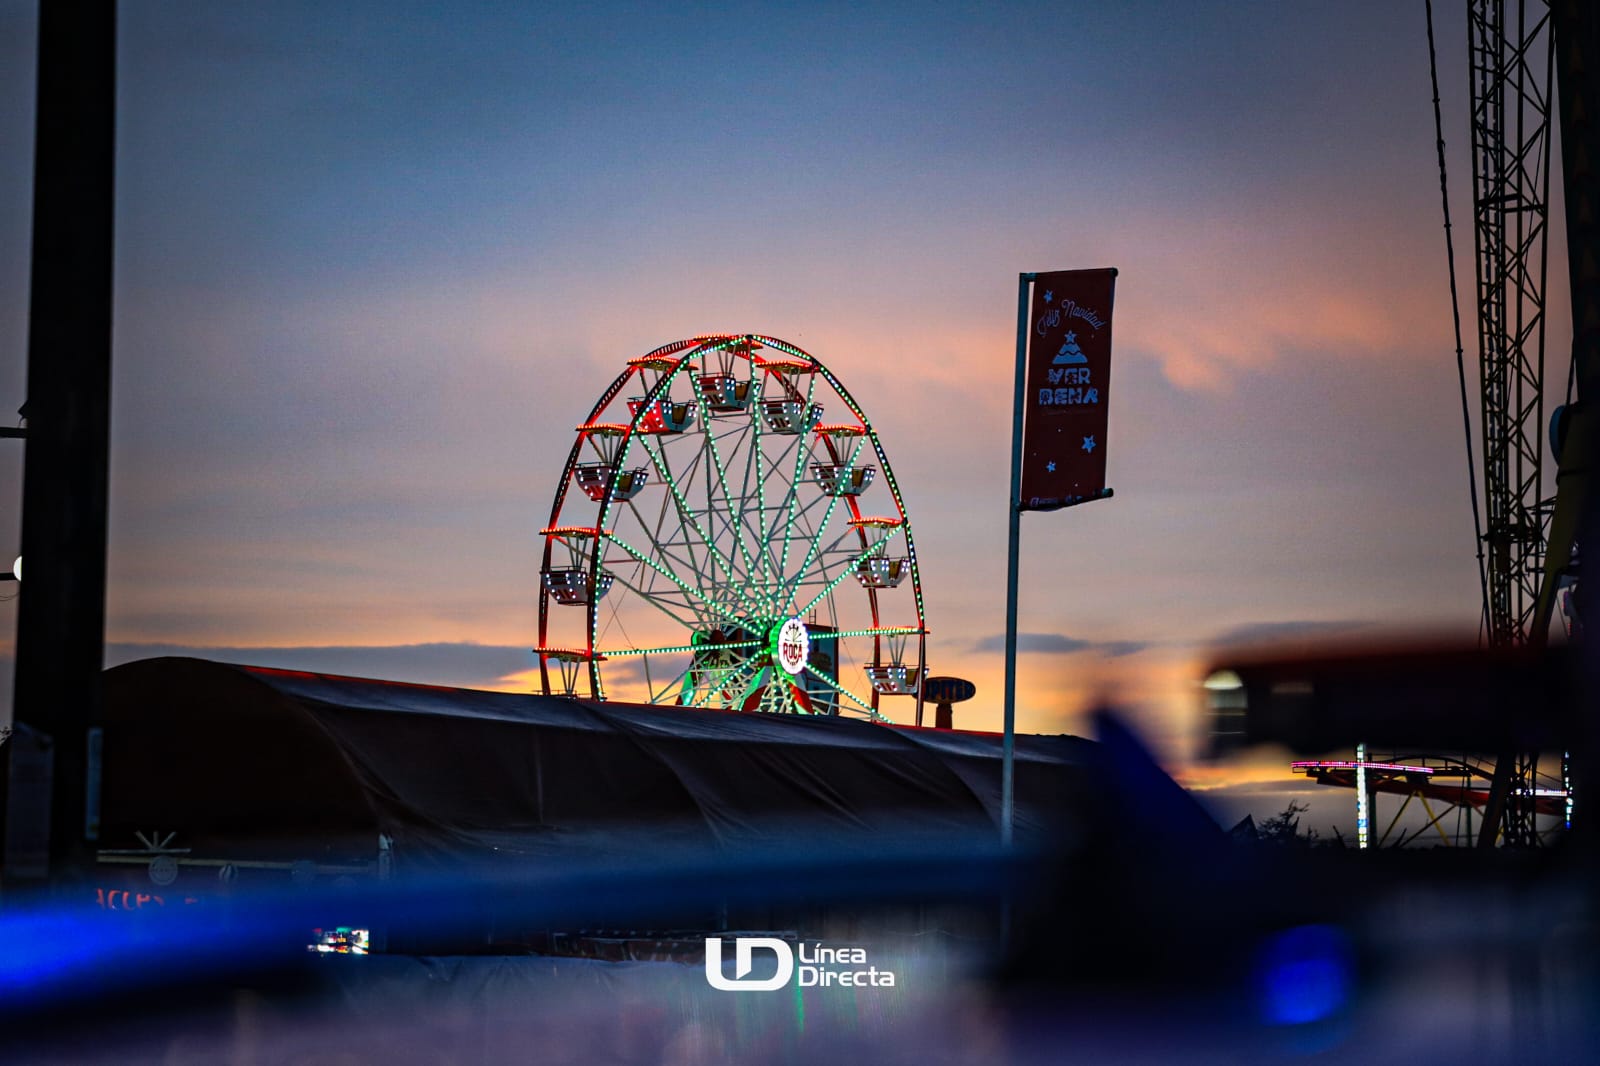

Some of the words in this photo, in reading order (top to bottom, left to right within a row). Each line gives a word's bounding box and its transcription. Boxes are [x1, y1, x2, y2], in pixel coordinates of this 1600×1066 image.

[1061, 299, 1106, 331] Navidad
[1048, 367, 1091, 385] VER
[1039, 386, 1099, 406] BENA
[783, 642, 803, 661] ROCA
[924, 680, 975, 702] PITER
